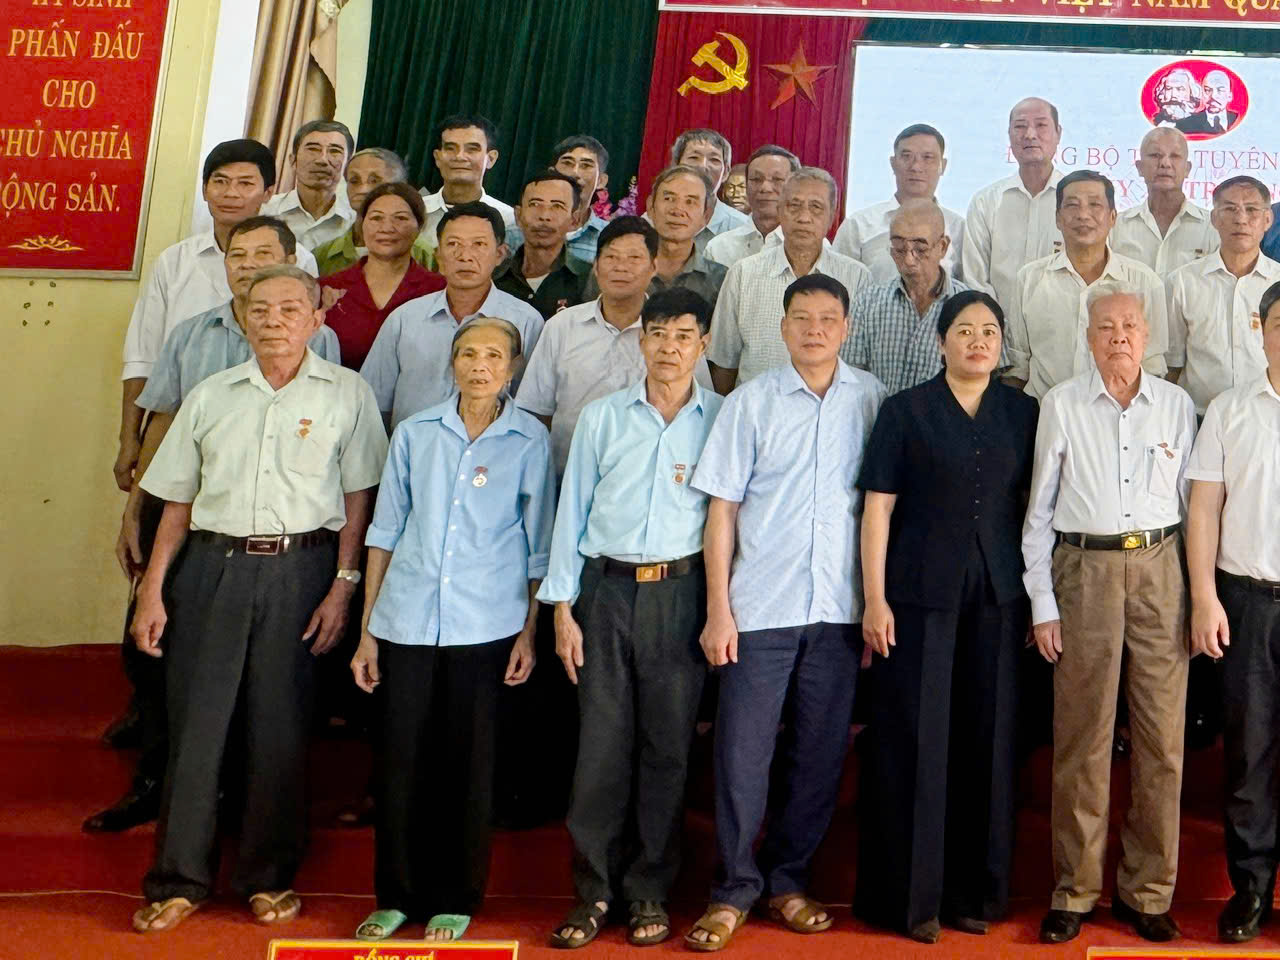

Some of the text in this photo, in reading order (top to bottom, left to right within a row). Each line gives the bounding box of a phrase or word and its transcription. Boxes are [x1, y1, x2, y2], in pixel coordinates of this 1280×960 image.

[7, 18, 145, 60] PHẤN ĐẤU
[42, 78, 97, 109] CHO
[49, 124, 133, 160] NGHĨA
[1087, 144, 1120, 171] BỘ
[1194, 147, 1279, 171] TUYÊN
[0, 171, 120, 218] ỘNG SẢN.
